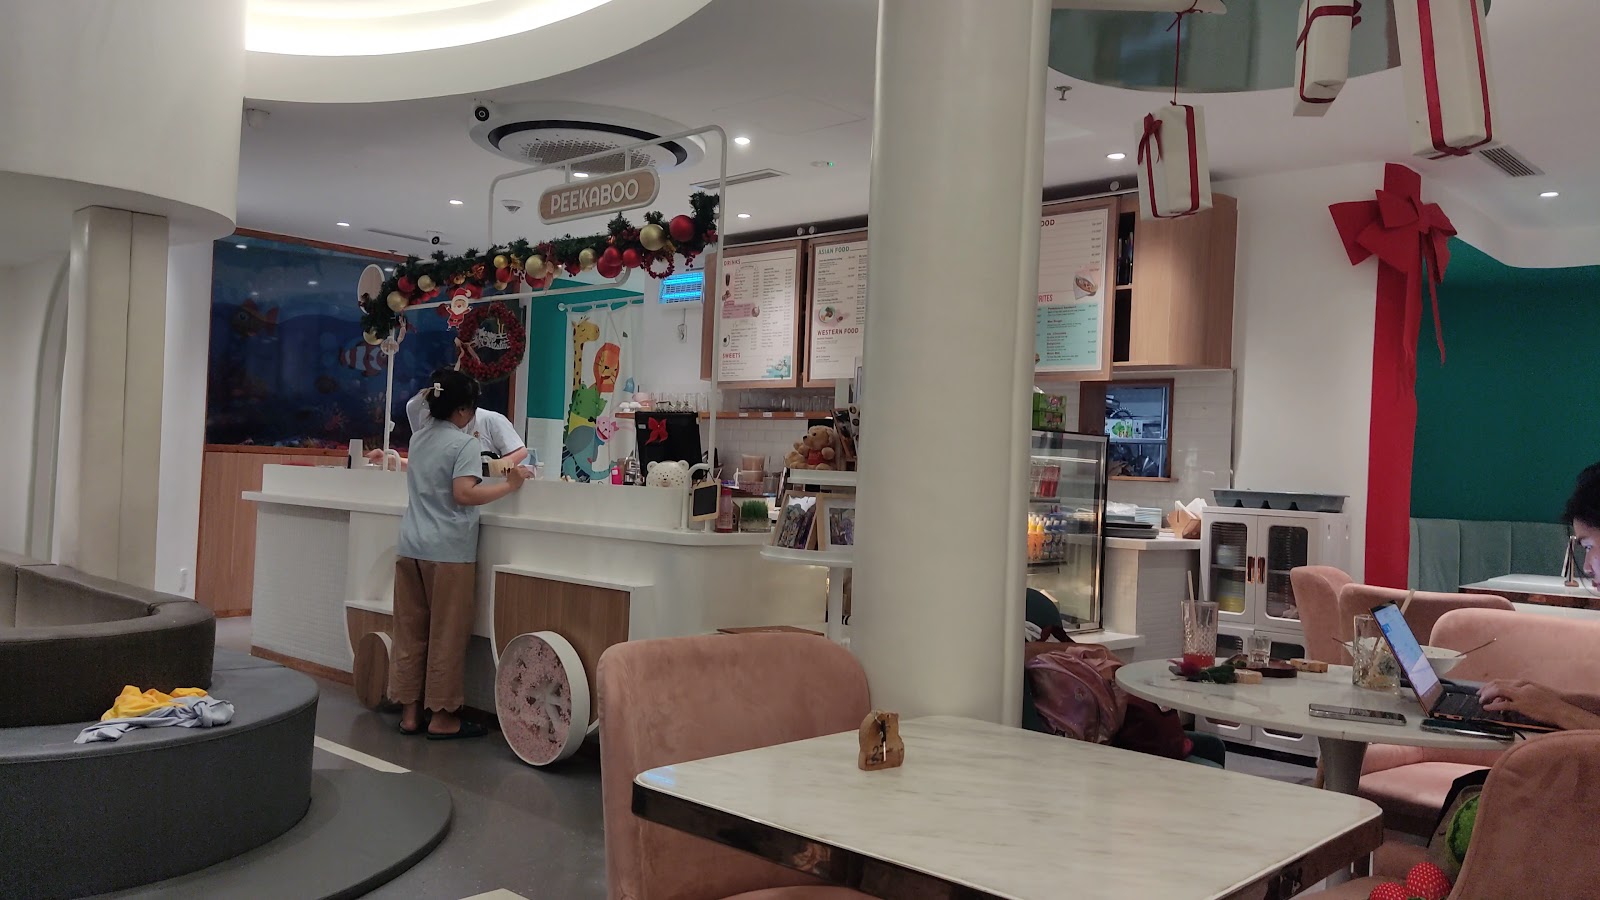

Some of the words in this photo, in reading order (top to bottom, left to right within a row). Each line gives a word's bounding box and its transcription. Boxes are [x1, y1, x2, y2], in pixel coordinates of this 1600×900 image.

[550, 179, 639, 215] PEEKABOO
[1041, 219, 1055, 227] OOD
[818, 247, 834, 255] ASIAN
[723, 258, 741, 267] DRINKS
[817, 328, 843, 336] WESTERN
